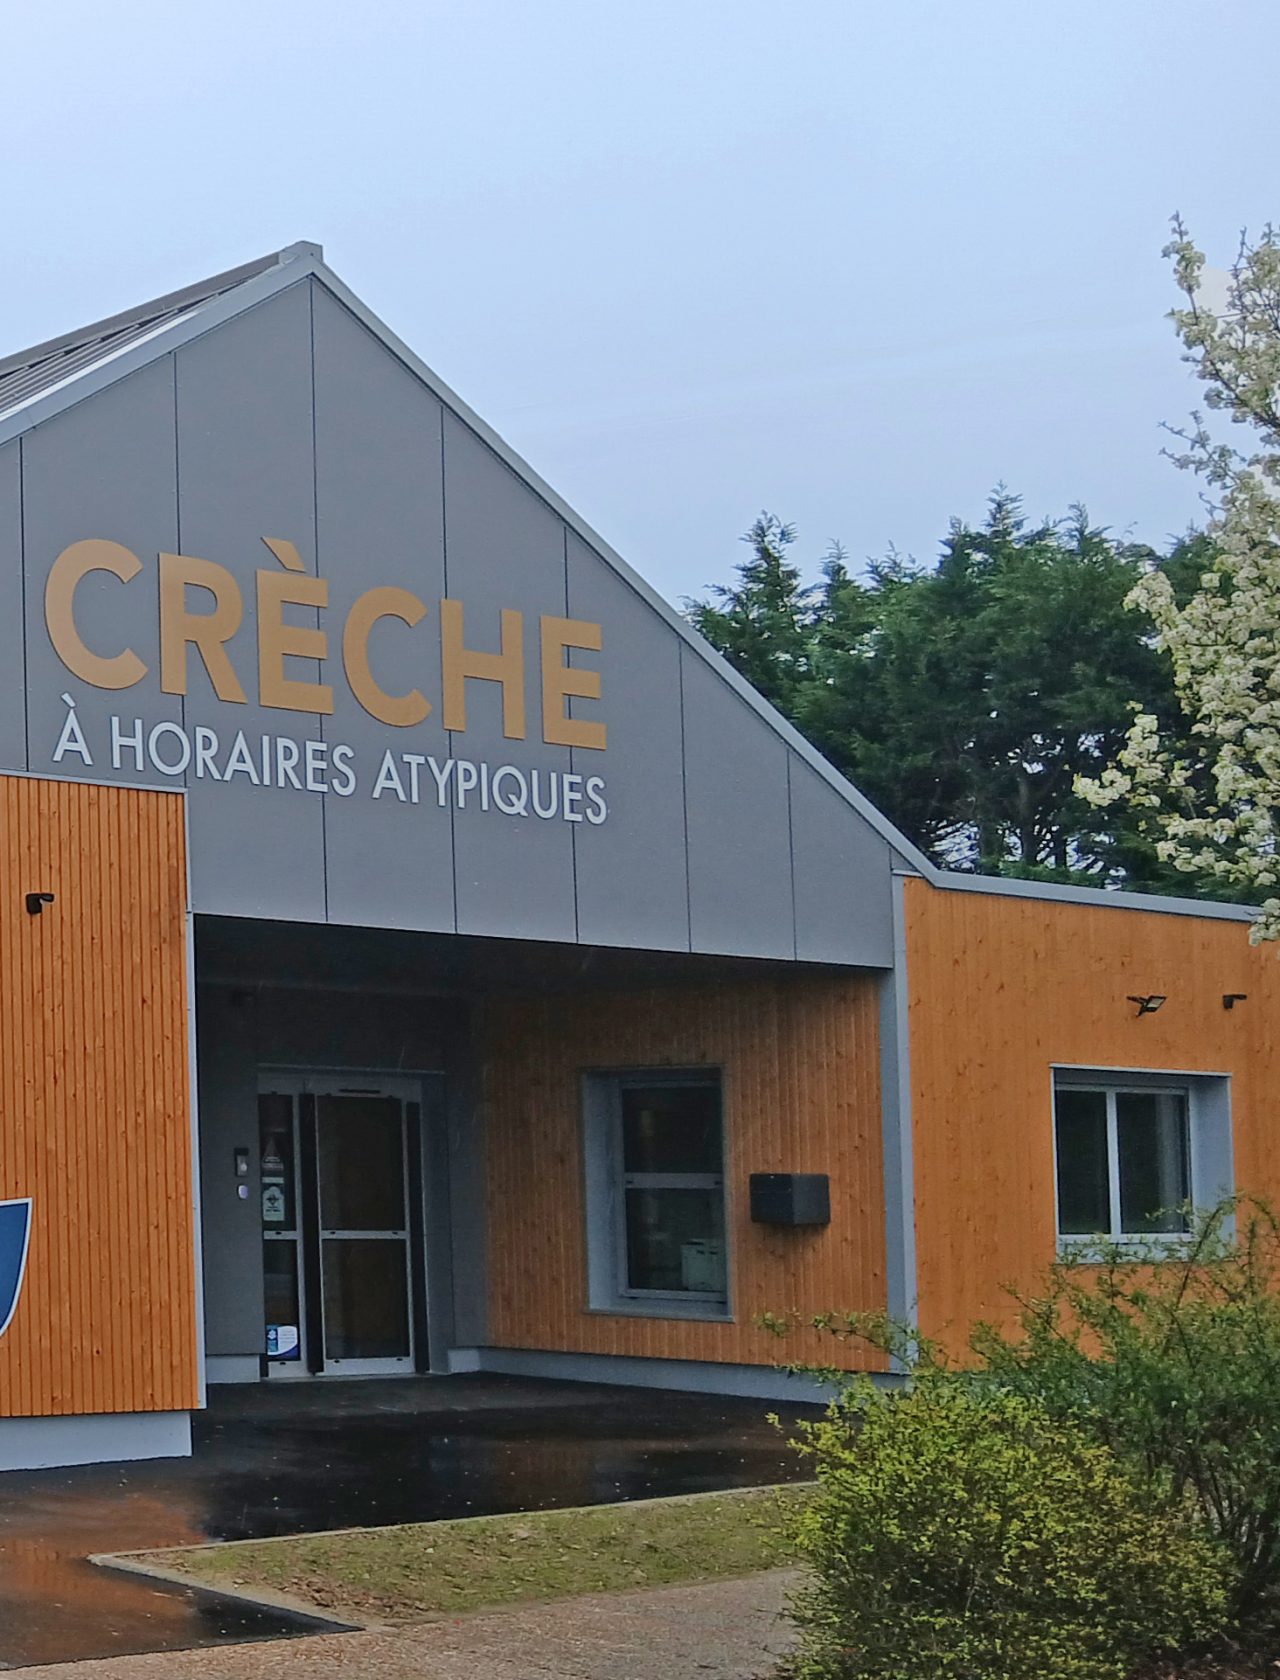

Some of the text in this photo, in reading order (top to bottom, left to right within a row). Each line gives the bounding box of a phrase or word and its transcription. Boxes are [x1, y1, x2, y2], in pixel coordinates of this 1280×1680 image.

[44, 536, 607, 751] CRÈCHE
[52, 693, 609, 825] À HORAIRES ATYPIQUES
